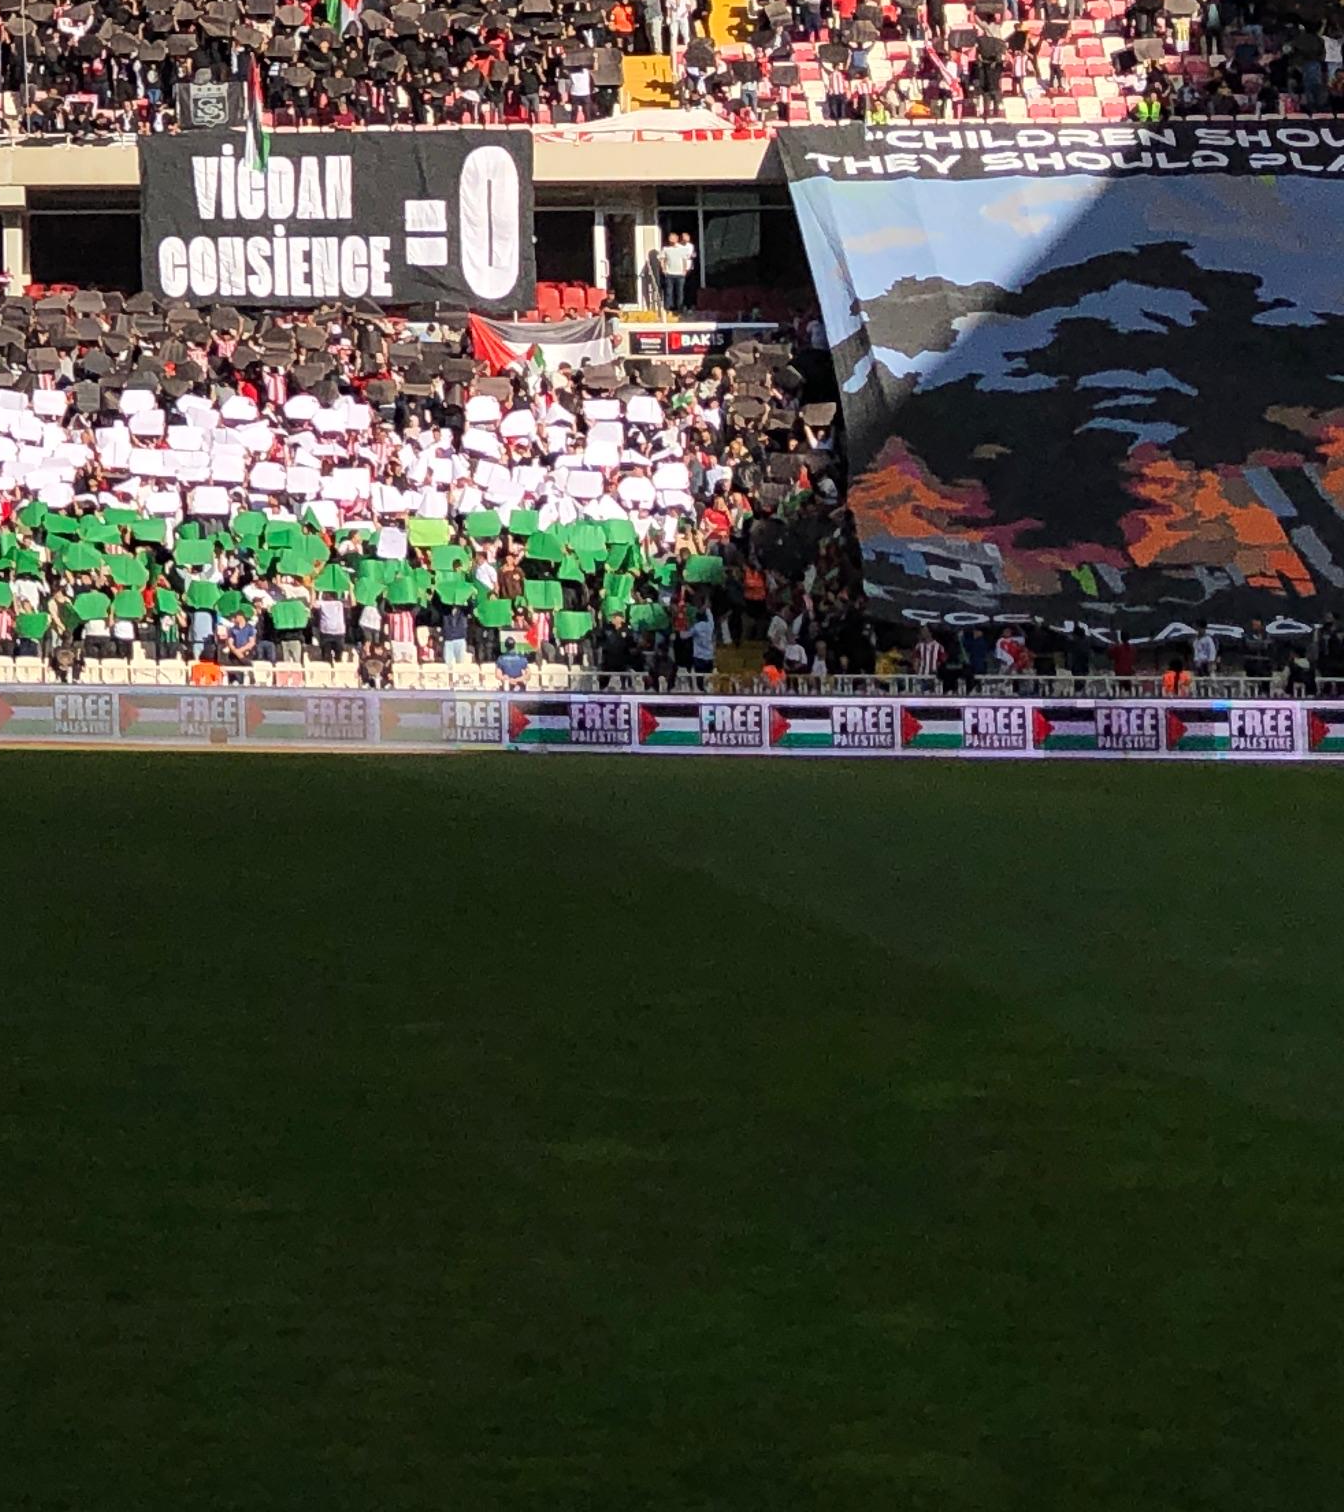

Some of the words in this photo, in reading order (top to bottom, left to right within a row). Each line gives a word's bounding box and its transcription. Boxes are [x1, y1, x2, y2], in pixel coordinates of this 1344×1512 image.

[804, 152, 963, 175] THEY
[982, 151, 1230, 174] SHOULD
[191, 143, 353, 220] VİCDAN
[158, 224, 393, 298] CONSİENCE
[55, 695, 111, 720] FREE
[180, 696, 238, 722] FREE
[308, 698, 364, 724] FREE
[442, 701, 501, 728] FREE
[571, 702, 631, 729] FREE
[702, 705, 761, 732] FREE
[832, 706, 893, 733] FREE
[964, 707, 1025, 734] FREE
[1096, 707, 1157, 735] FREE
[1230, 708, 1293, 736] FREE
[702, 732, 761, 745] PALESTINE
[832, 733, 893, 747] PALESTINE
[964, 735, 1025, 748] PALESTINE
[1230, 736, 1293, 750] PALESTINE
